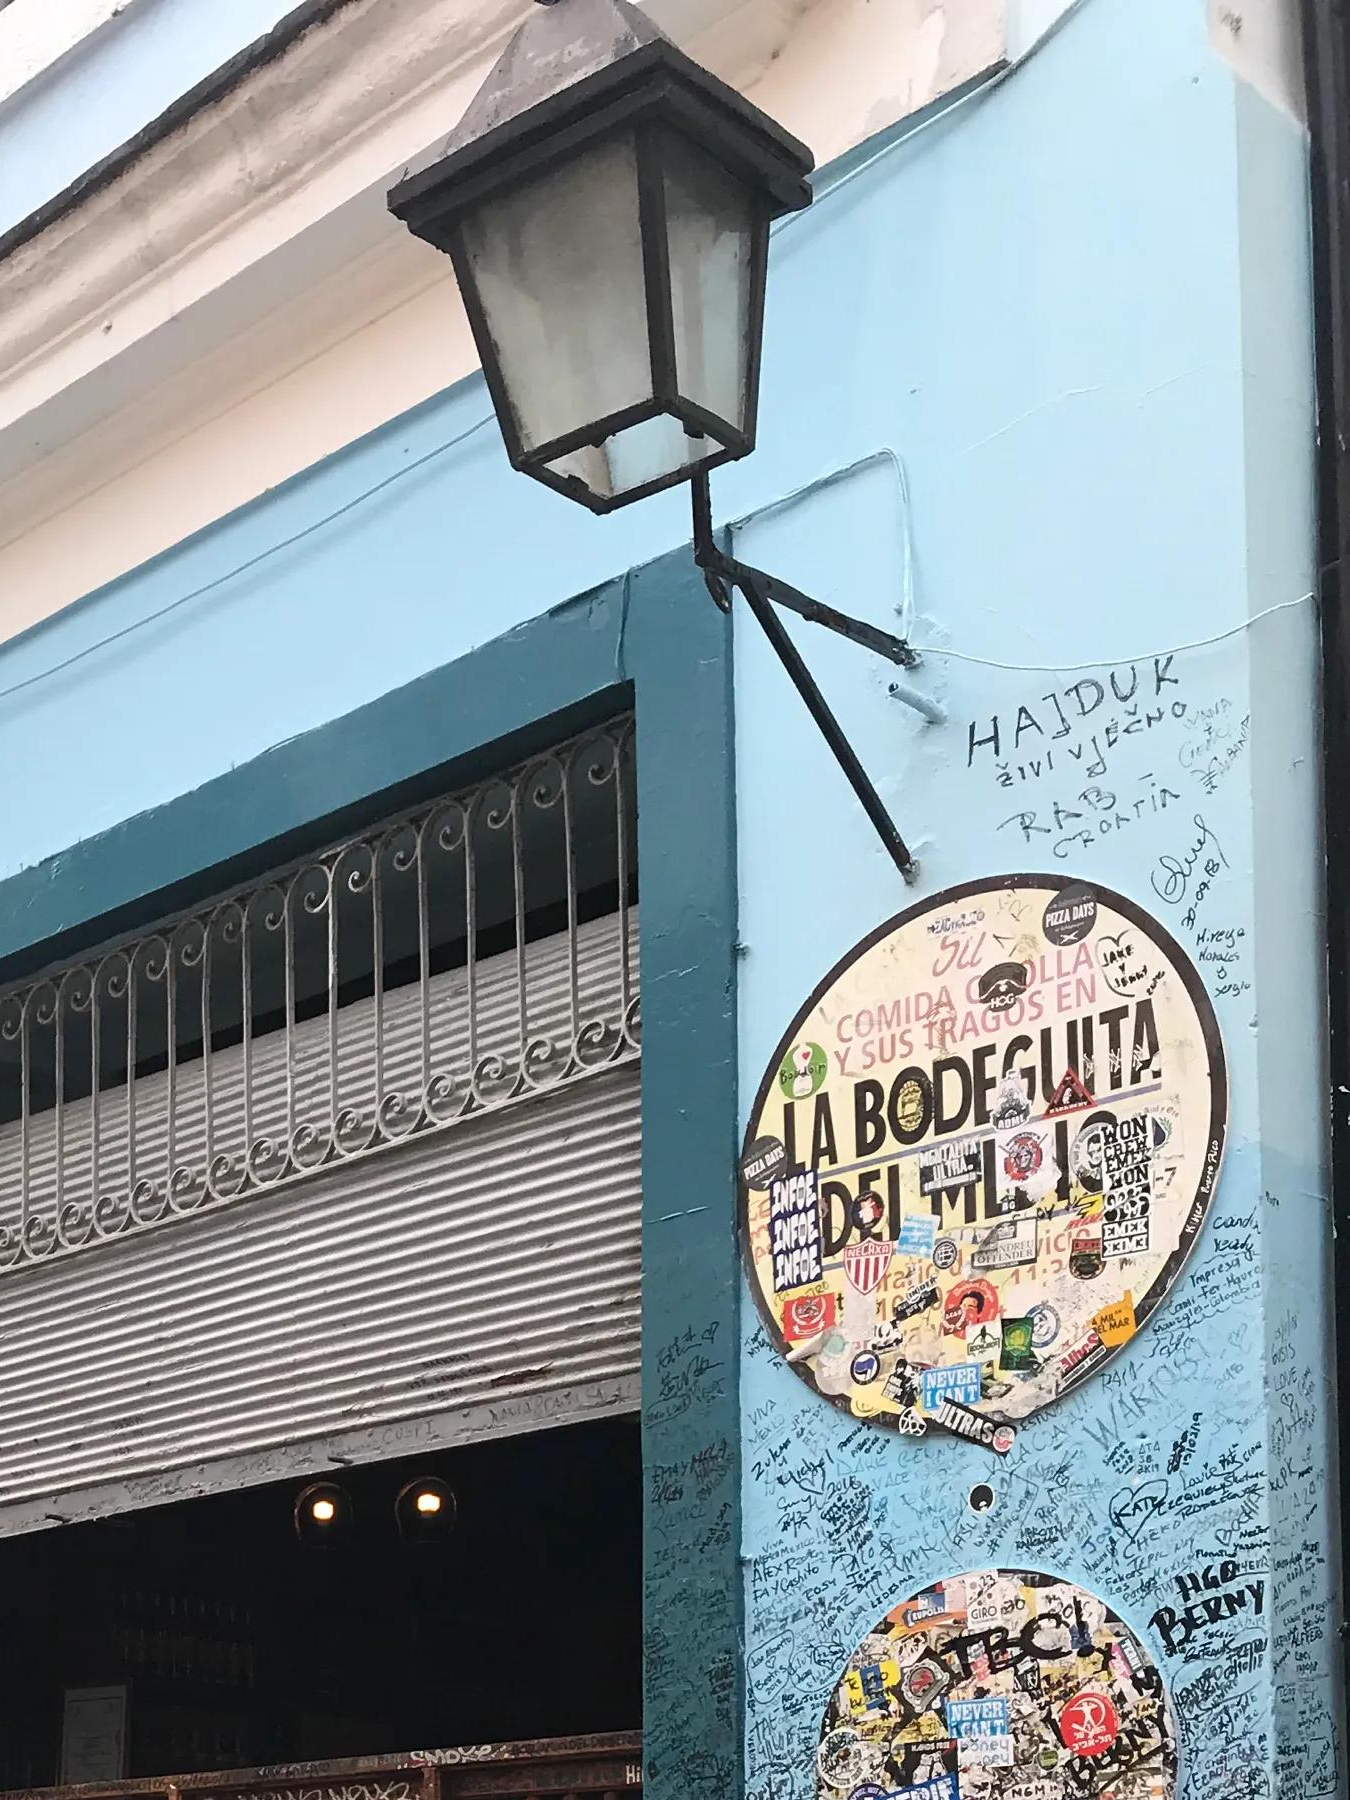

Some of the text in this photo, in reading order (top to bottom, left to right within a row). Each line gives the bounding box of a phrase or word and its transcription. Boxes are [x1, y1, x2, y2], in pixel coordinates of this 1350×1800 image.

[968, 654, 1178, 767] HAJDUK
[1045, 902, 1095, 928] PIZZA DAYS
[836, 942, 1095, 1043] COMIDA COLLA
[990, 993, 1016, 1009] HOG
[834, 974, 1097, 1076] Y SUS TRAGOS EN
[783, 998, 1161, 1171] LA BODEGUITA
[1101, 1115, 1148, 1144] WON
[1103, 1134, 1149, 1160] CREW
[743, 1146, 785, 1180] PIZZA DAYS
[847, 1244, 890, 1258] NECAXA
[977, 1249, 1035, 1264] OFFENDER
[926, 1367, 978, 1390] NEVER
[936, 1402, 995, 1448] ULTRAS
[970, 1605, 997, 1621] GIRO
[1148, 1580, 1264, 1653] BERNY
[951, 1701, 1004, 1721] NEVER
